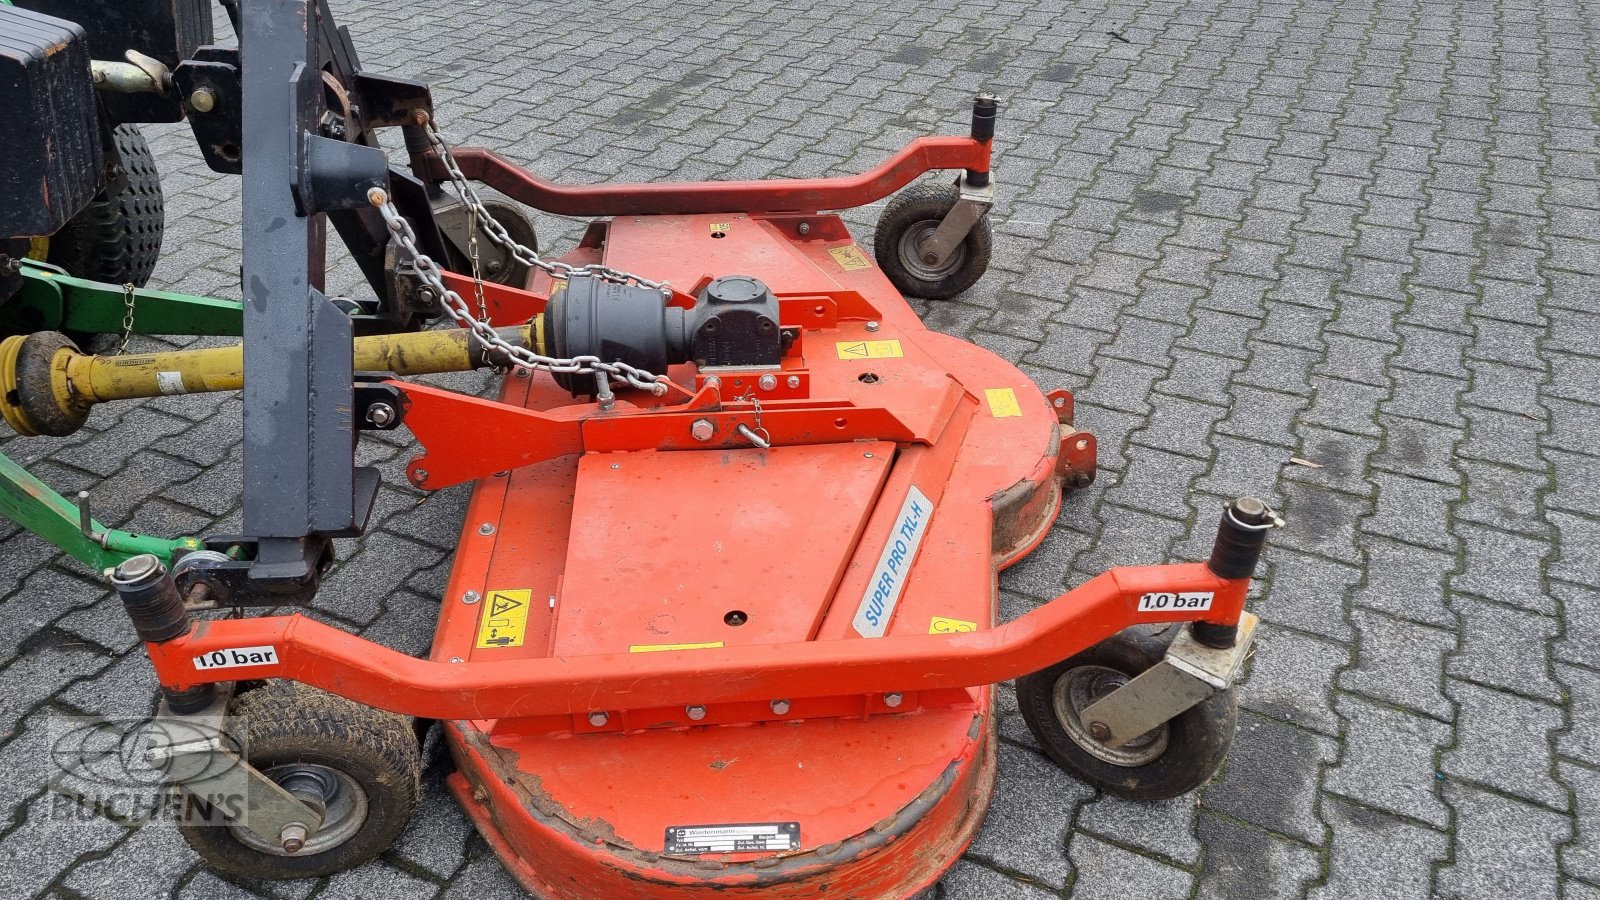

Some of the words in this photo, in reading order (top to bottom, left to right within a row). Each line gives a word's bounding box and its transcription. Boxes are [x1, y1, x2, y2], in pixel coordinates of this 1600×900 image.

[865, 571, 895, 627] SUPER
[887, 539, 907, 576] PRO
[899, 500, 923, 542] TXL-H
[1173, 594, 1210, 608] bar
[231, 650, 273, 665] bar
